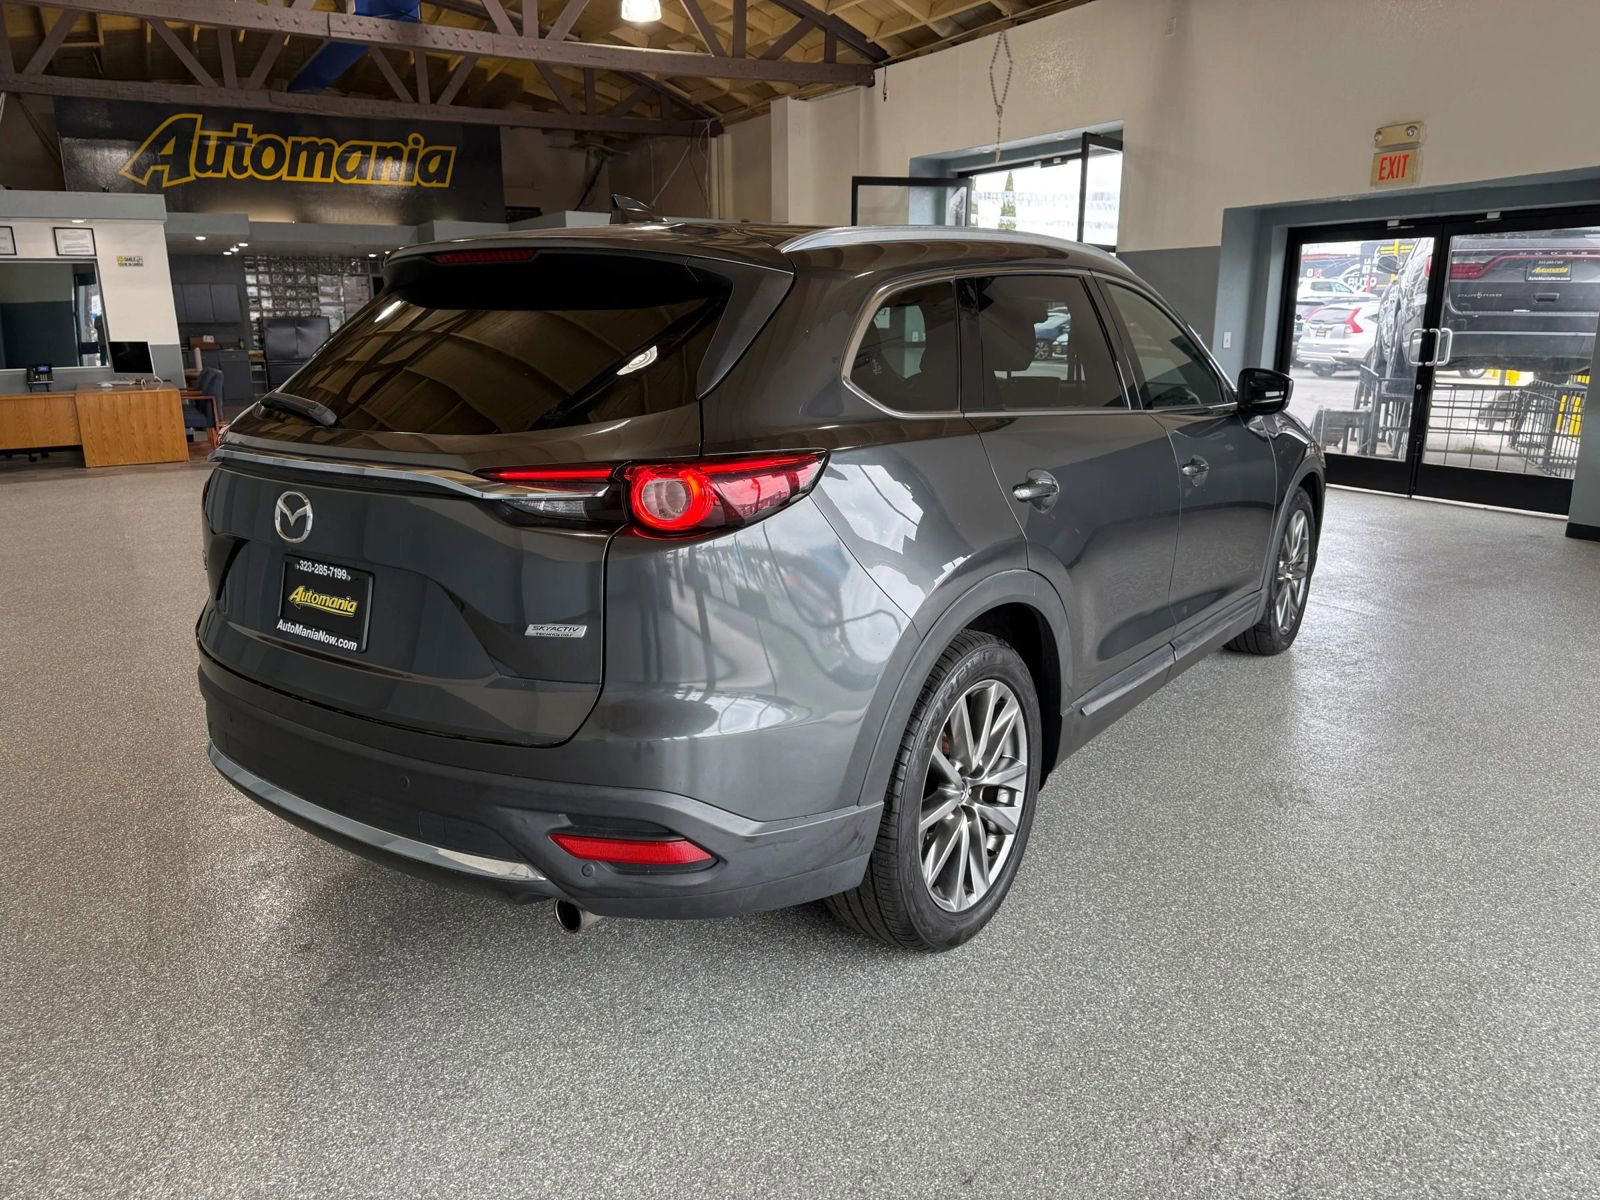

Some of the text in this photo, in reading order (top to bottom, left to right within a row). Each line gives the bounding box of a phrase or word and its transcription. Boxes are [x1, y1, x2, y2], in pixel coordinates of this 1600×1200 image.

[119, 113, 456, 188] Automania
[1379, 154, 1409, 180] EXIT
[299, 560, 347, 580] 323-285-7199
[288, 585, 358, 613] Automania
[276, 619, 358, 651] AutoManiaNow.com
